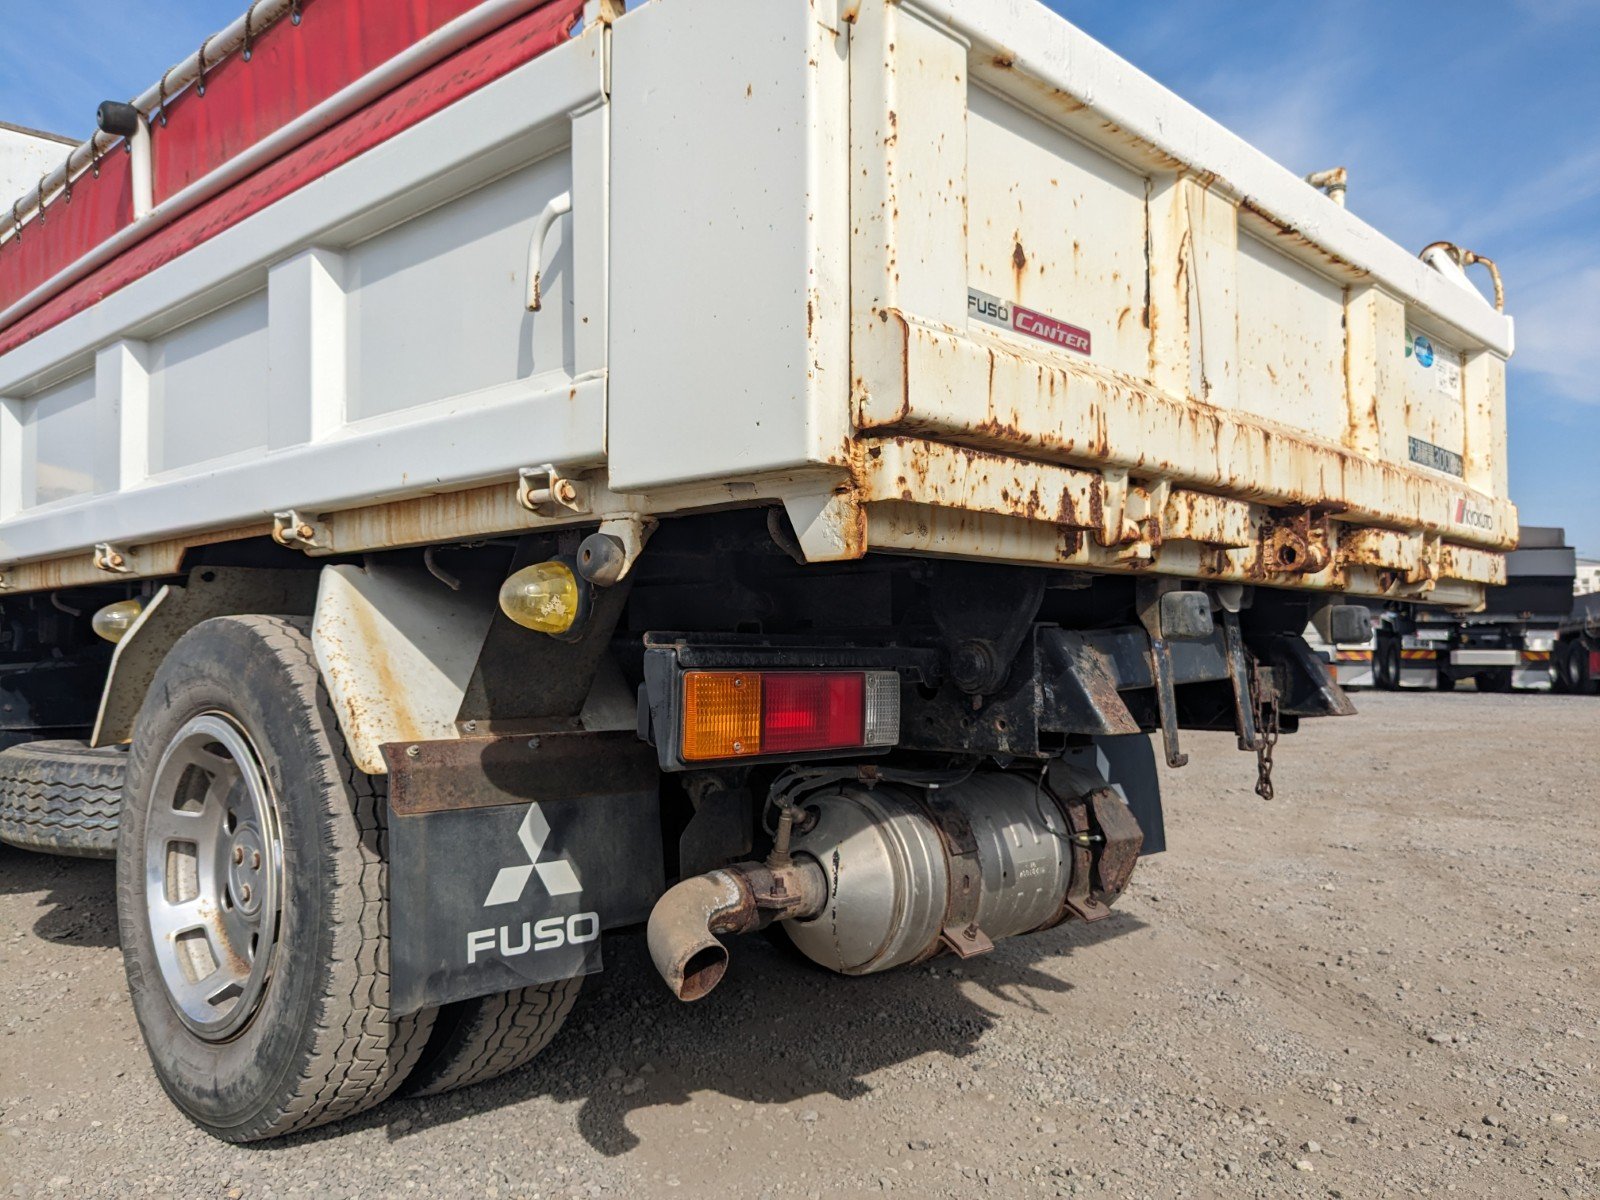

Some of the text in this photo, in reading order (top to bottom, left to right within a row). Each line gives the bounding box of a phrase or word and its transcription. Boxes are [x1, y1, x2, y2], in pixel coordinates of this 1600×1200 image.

[968, 294, 1089, 351] FUSO CANTER
[466, 911, 600, 965] FUSO
